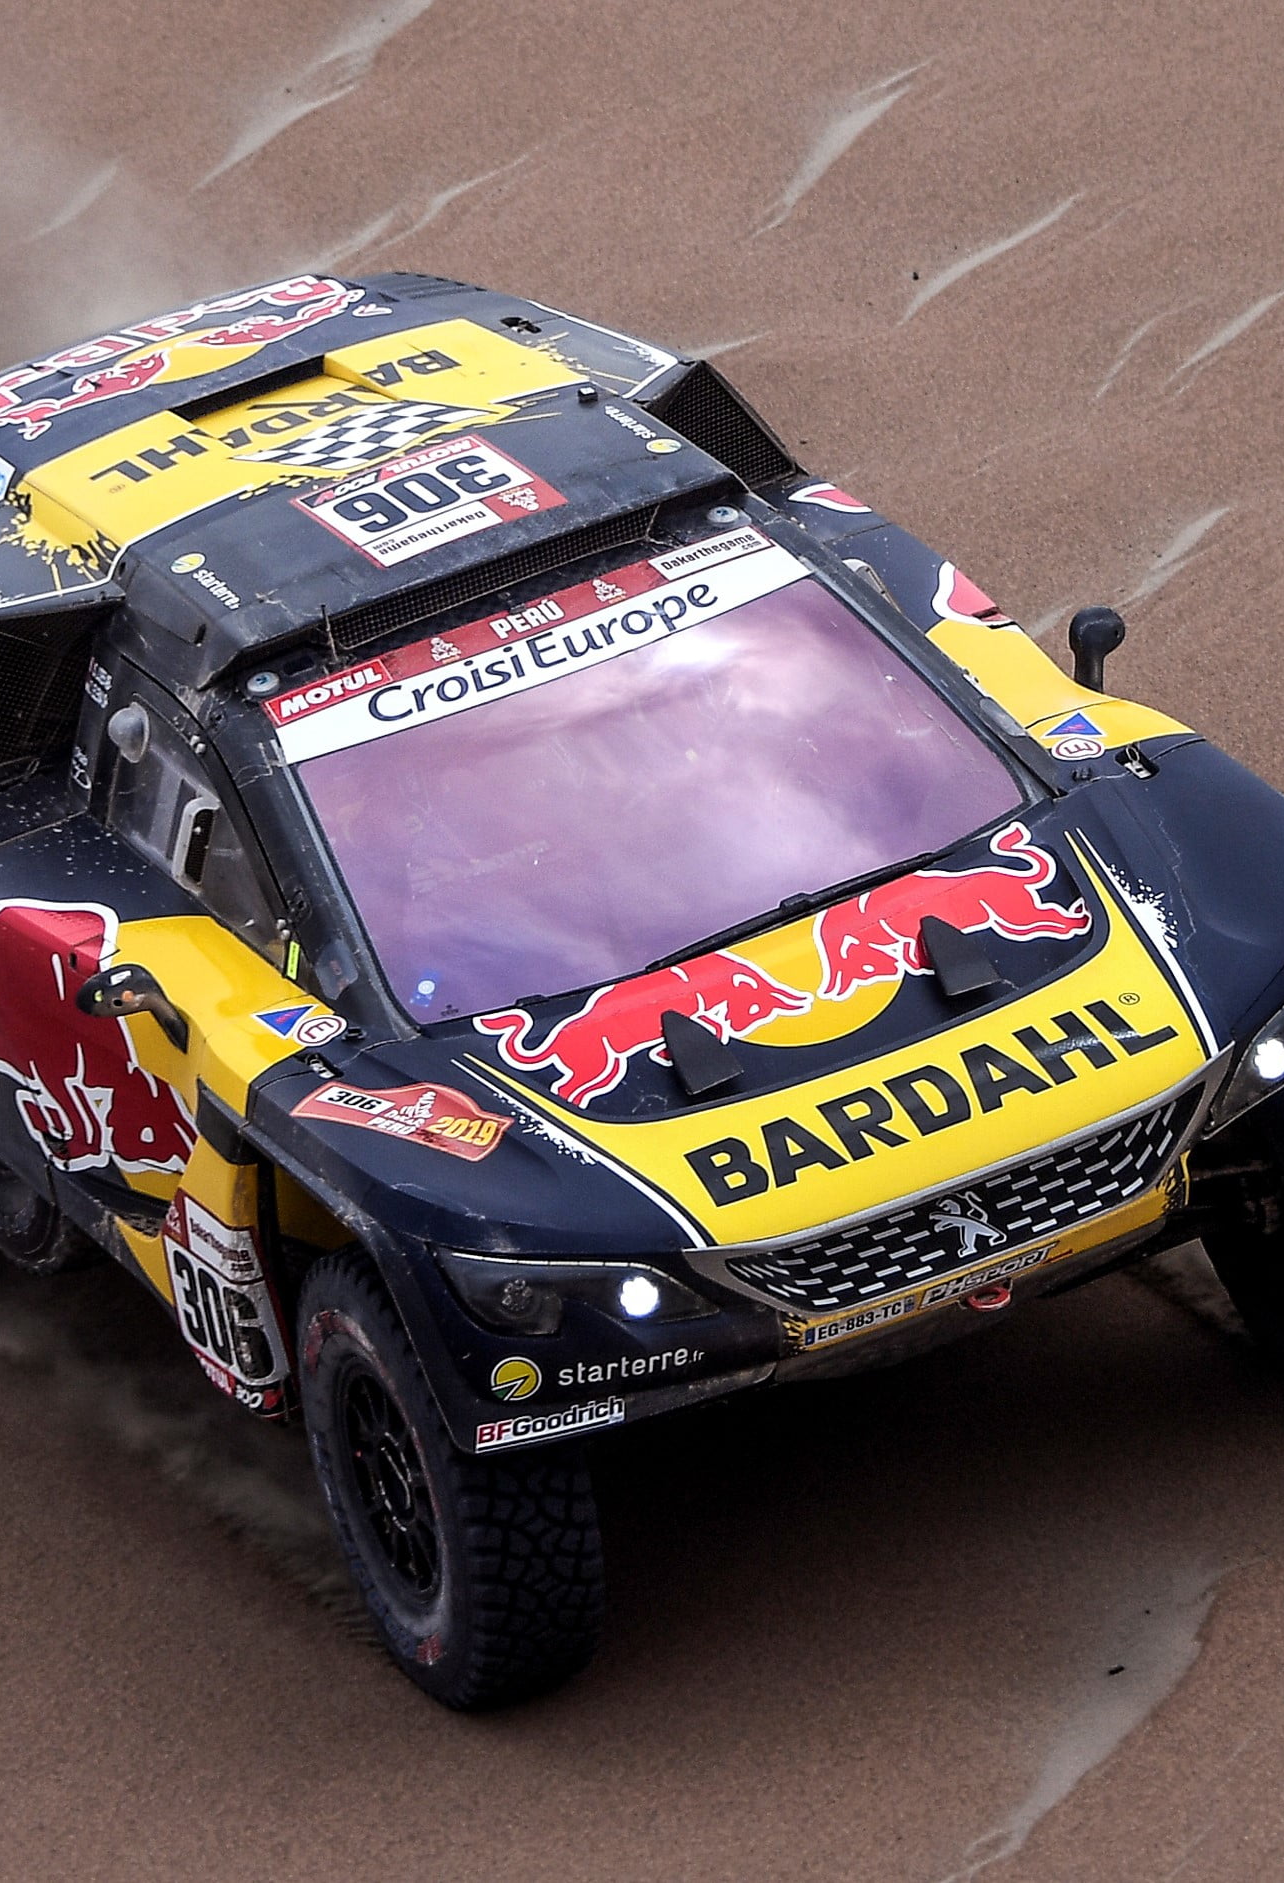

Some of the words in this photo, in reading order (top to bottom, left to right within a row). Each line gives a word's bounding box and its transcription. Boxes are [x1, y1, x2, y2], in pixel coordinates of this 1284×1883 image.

[89, 350, 461, 483] BARDAHL
[385, 440, 474, 474] MOTUL
[332, 454, 512, 533] 306
[380, 511, 487, 556] Dakarthegame
[661, 533, 756, 570] Dakarthegame
[489, 598, 565, 640] PERÚ
[368, 583, 718, 721] CroisiEurope
[280, 667, 383, 718] MOTUL
[327, 1089, 383, 1111] 306
[685, 1000, 1178, 1207] BARDAHL
[425, 1116, 498, 1147] 2019
[174, 1250, 275, 1379] 306
[817, 1303, 903, 1341] EG-883-TC
[558, 1348, 705, 1386] starterre.fr
[478, 1396, 624, 1445] BFGoodrich
